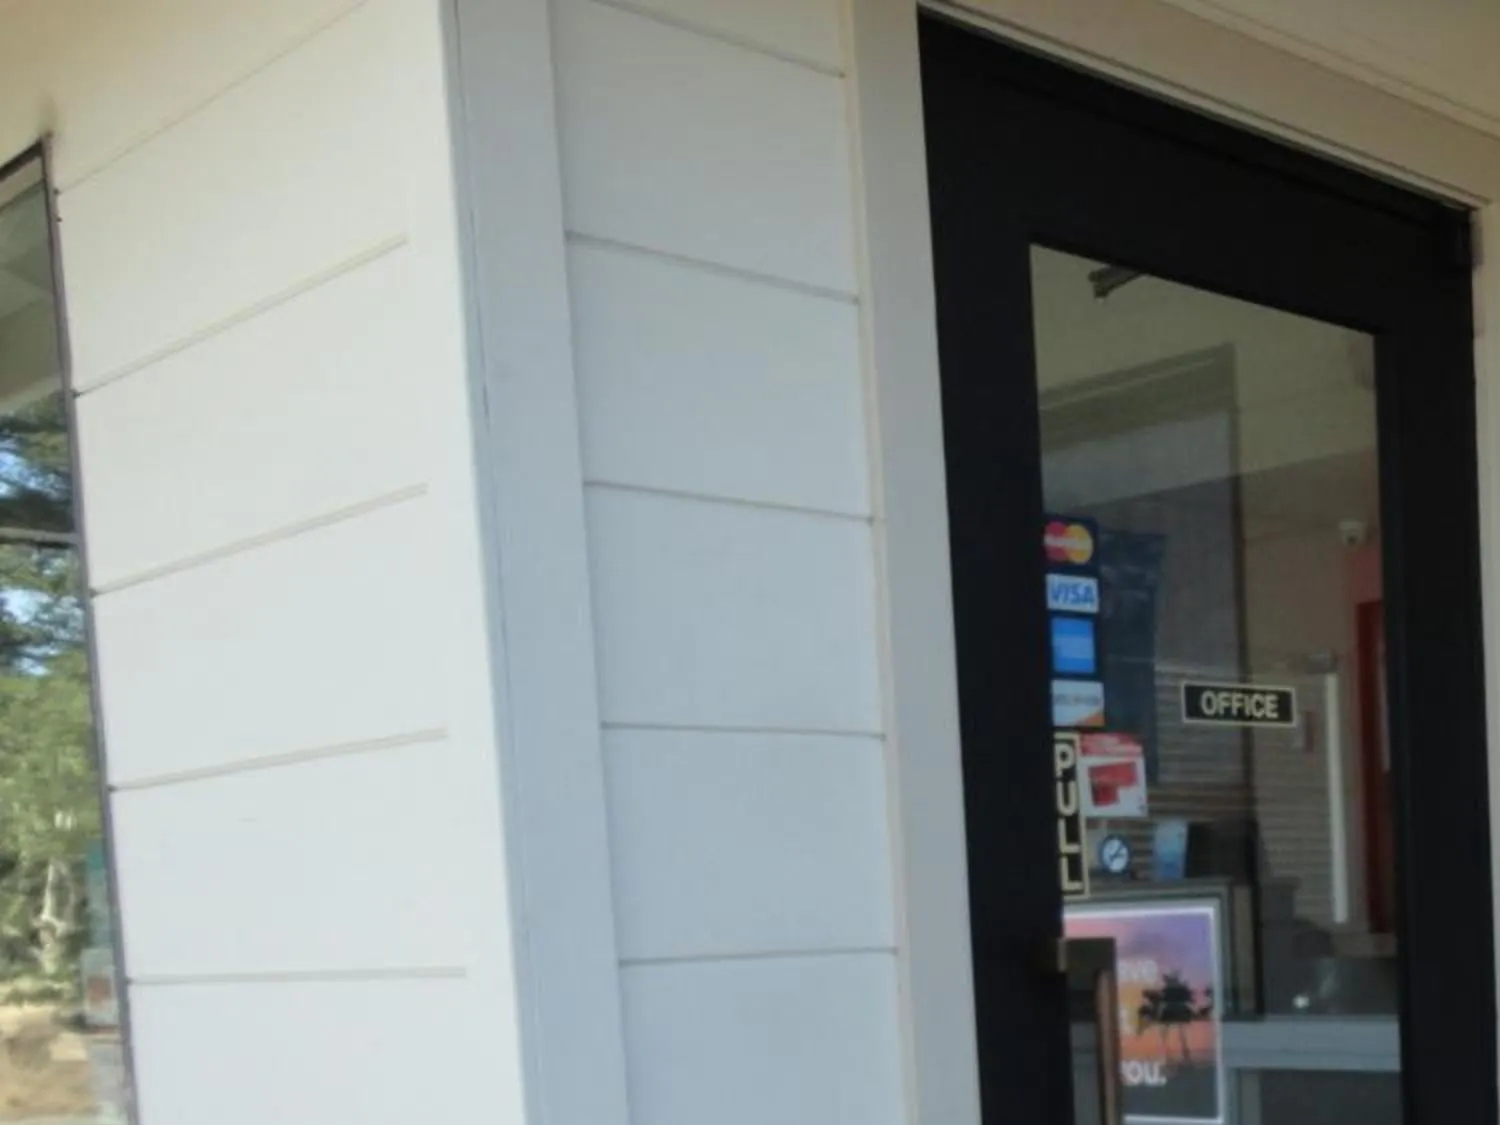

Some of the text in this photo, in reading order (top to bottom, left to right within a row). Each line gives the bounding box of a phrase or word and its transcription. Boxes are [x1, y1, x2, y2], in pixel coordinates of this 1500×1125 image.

[1051, 582, 1095, 606] VISA
[1200, 690, 1279, 719] OFFICE
[1055, 743, 1083, 892] PULL
